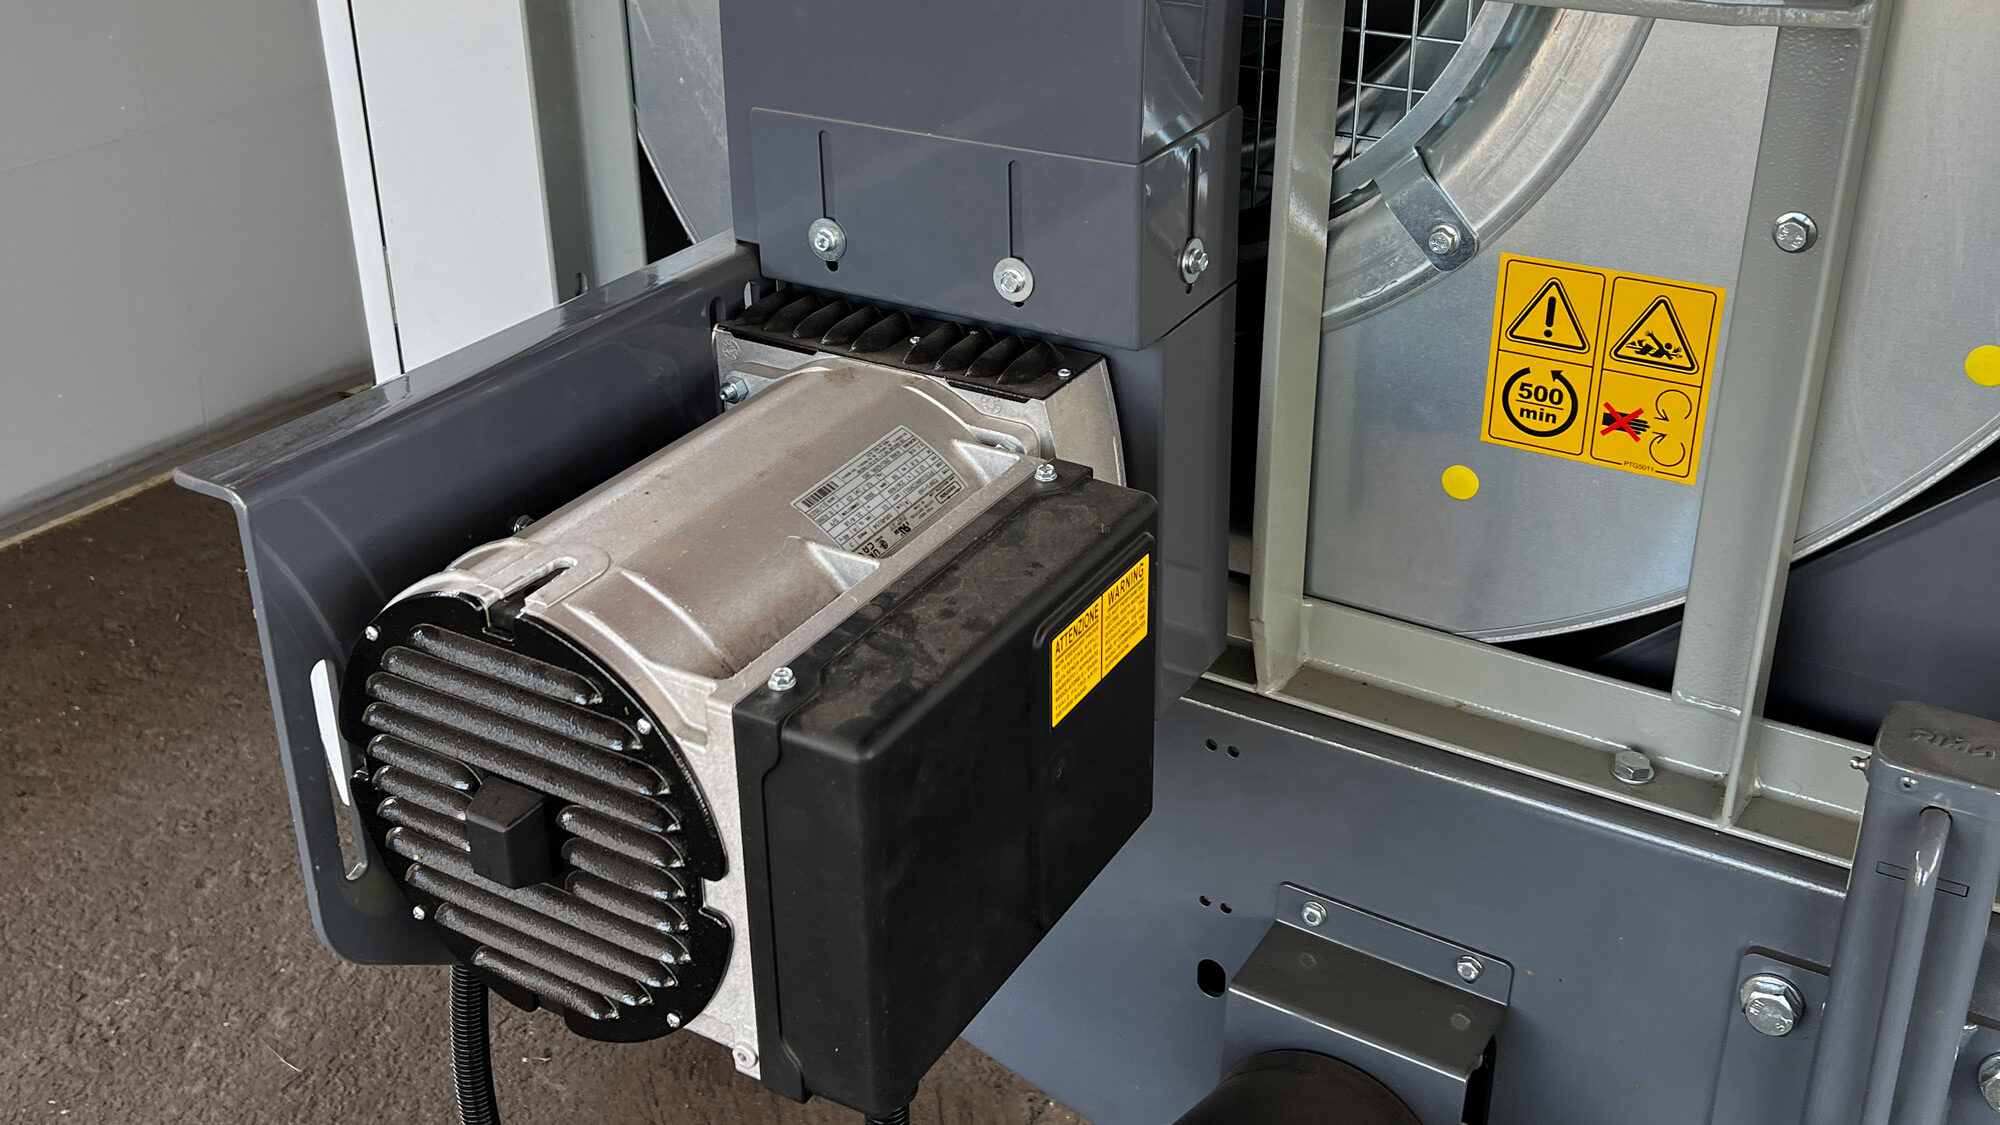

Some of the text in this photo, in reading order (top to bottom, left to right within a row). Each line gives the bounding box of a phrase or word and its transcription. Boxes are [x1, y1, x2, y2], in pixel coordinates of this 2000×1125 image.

[1518, 382, 1563, 406] 500
[1519, 406, 1557, 424] min
[1623, 461, 1655, 472] PTG5011
[1107, 561, 1143, 607] WARNING
[1055, 602, 1098, 656] ATTENZIONE
